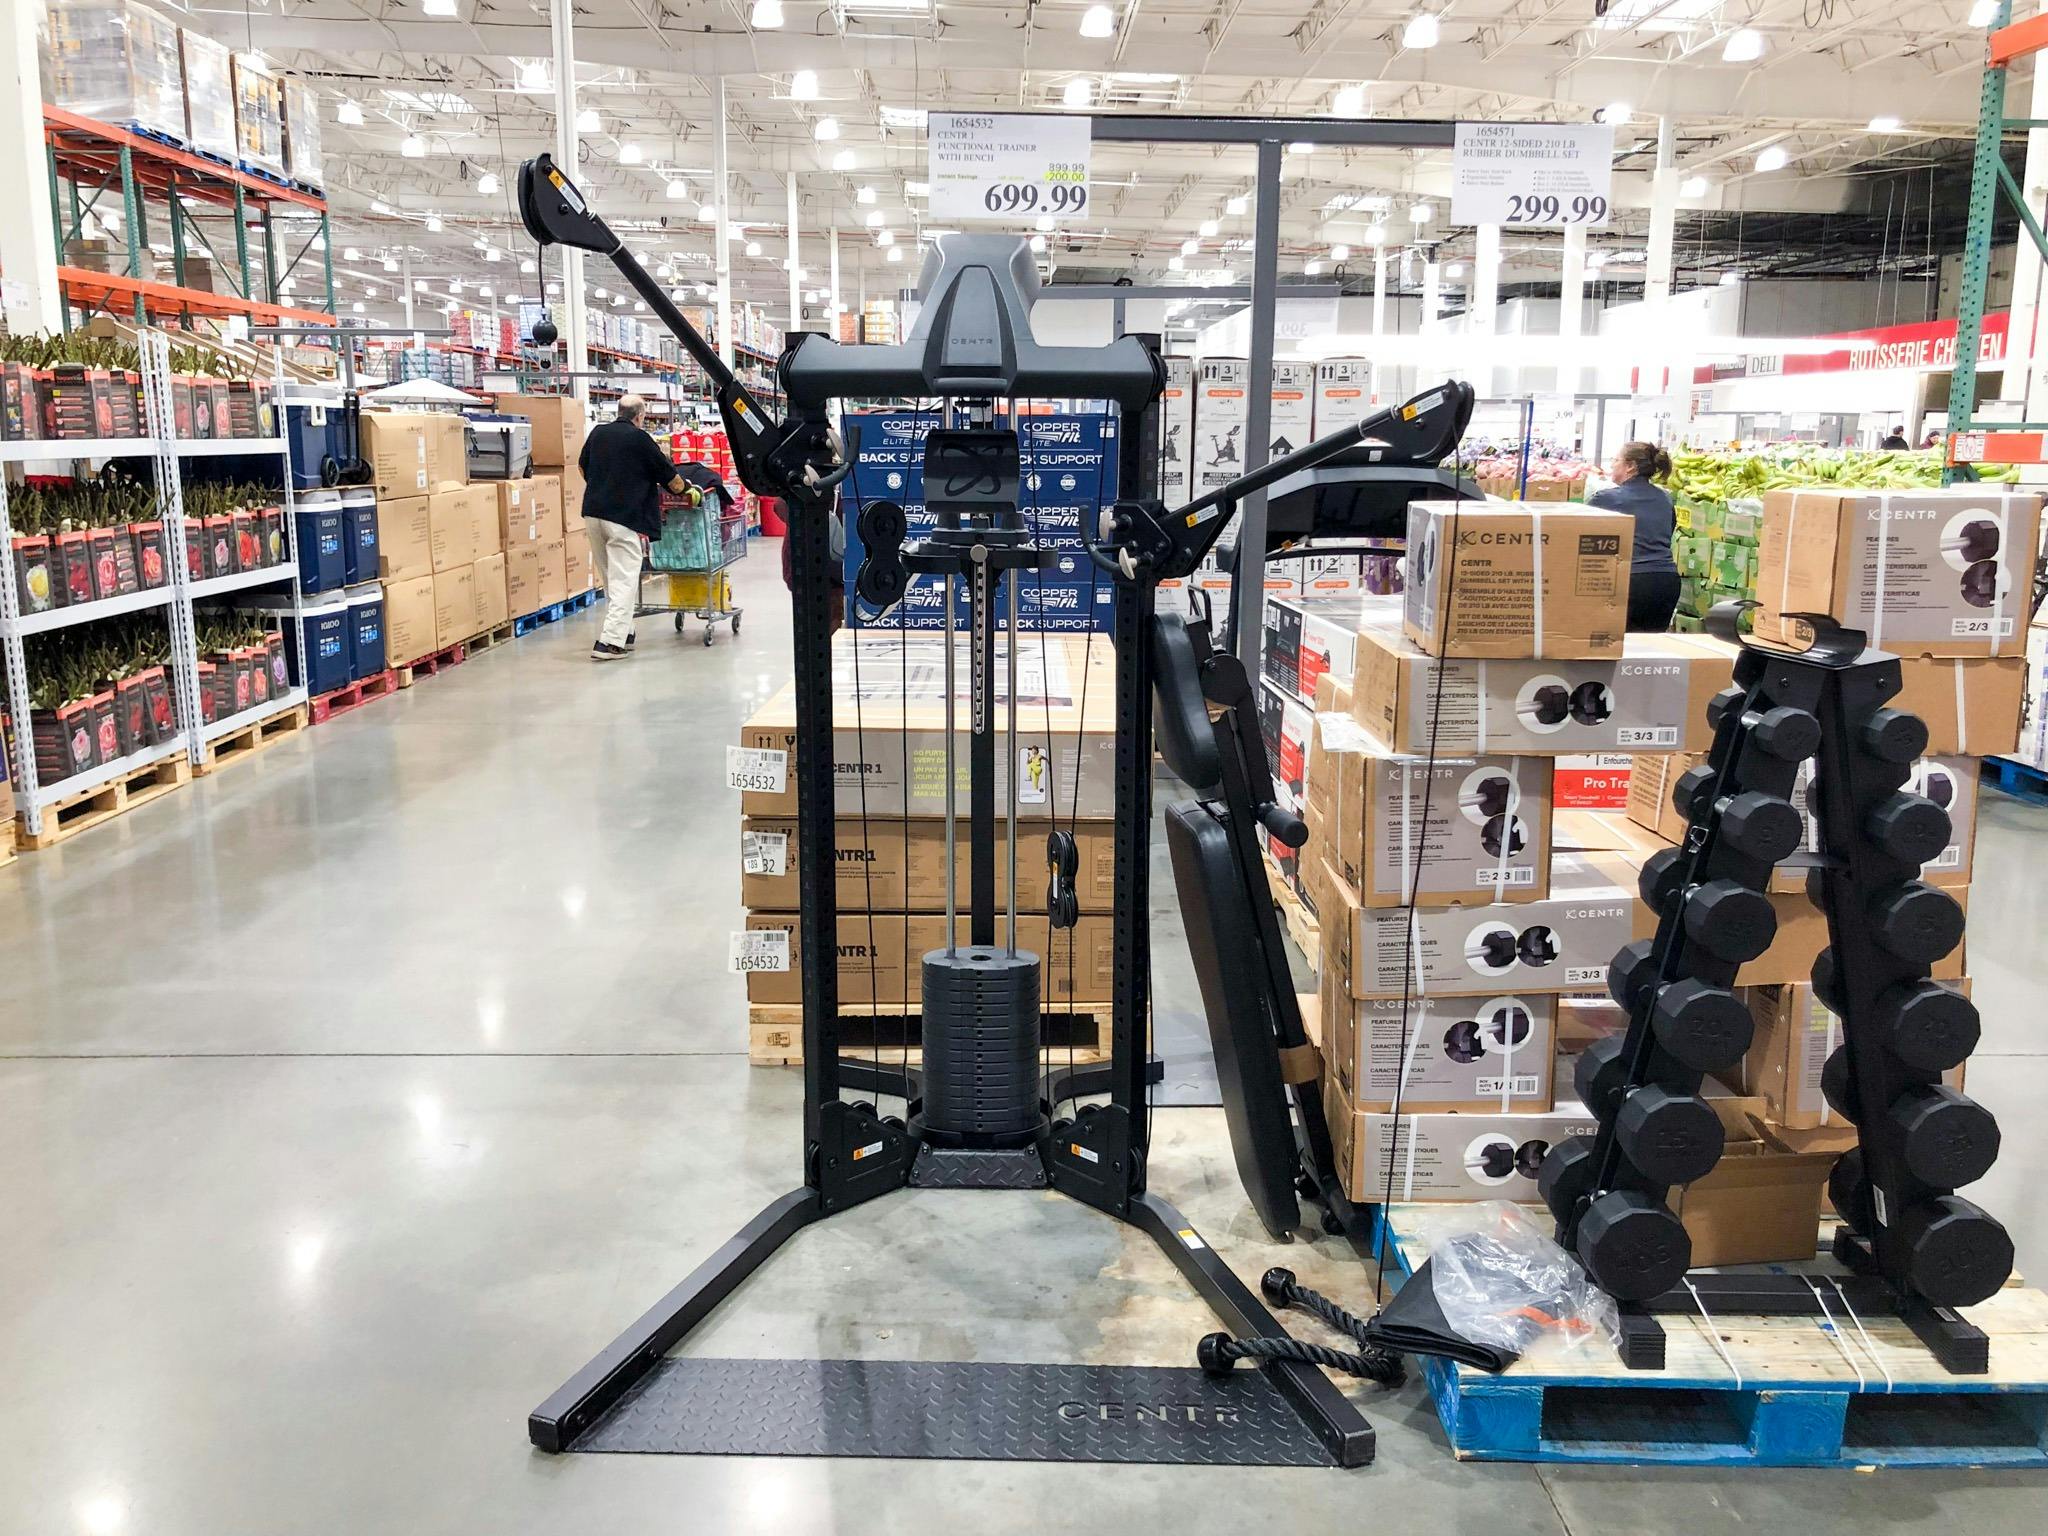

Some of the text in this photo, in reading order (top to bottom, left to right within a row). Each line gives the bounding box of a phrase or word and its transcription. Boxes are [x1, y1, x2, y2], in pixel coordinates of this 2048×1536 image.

[951, 118, 993, 128] 1654532
[938, 131, 967, 139] CENTR
[1476, 127, 1515, 137] 1654571
[938, 143, 1036, 152] FUNCTIONAL TRAINER
[1463, 139, 1576, 148] CENTR 12-SIDED 210 LB
[964, 154, 994, 162] BENCH
[1463, 150, 1580, 159] RUBBER DUMBBELL SET
[1049, 163, 1085, 172] 899.99
[984, 184, 1087, 213] 699.99
[1506, 195, 1607, 224] 299.99
[1850, 333, 2003, 371] ROTISSERIE CHEN
[1752, 356, 1776, 374] DELI
[1224, 366, 1232, 375] 3
[1283, 368, 1291, 377] 3
[1341, 366, 1349, 375] 3
[882, 421, 940, 430] COPPER
[1023, 423, 1081, 432] COPPER
[859, 453, 897, 463] BACK
[1040, 455, 1103, 465] SUPPORT
[1023, 507, 1080, 516] COPPER
[1886, 511, 1937, 520] CENTR
[1040, 538, 1084, 548] SUPPO
[1480, 534, 1550, 545] CENTR
[1596, 540, 1618, 551] 1/3
[1022, 589, 1078, 597] COPPER
[999, 620, 1100, 629] BCK SUPPORT
[1969, 622, 1989, 632] 2/3
[1634, 667, 1681, 675] CENTR
[1634, 732, 1653, 741] 3/3
[834, 764, 882, 774] CENTR 1
[1406, 770, 1454, 780] ENTR
[732, 772, 775, 790] 1654532
[1584, 777, 1607, 789] Pro
[835, 850, 876, 862] NTR 1
[1492, 872, 1511, 881] 23
[1580, 908, 1624, 919] CENTR
[836, 946, 878, 957] NTR 1
[735, 956, 780, 971] 1654532
[1582, 971, 1601, 979] 3/3
[1386, 1000, 1435, 1009] CENTR
[1058, 1402, 1240, 1423] CENTR
